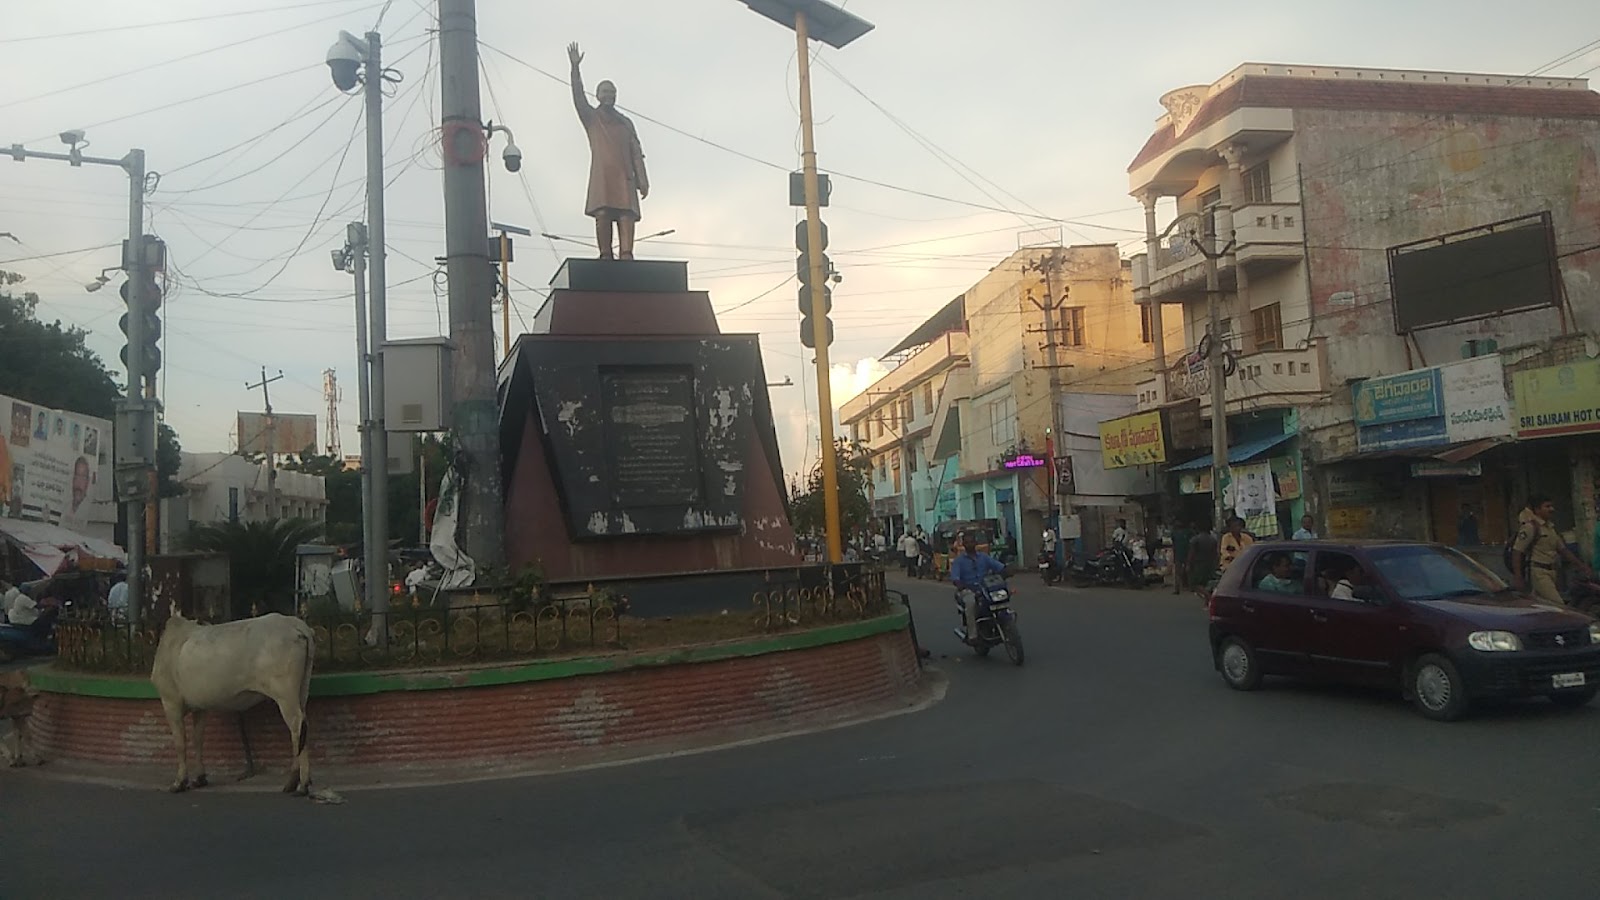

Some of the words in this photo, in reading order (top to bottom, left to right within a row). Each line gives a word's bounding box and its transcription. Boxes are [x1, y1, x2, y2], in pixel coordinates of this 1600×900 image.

[1520, 416, 1535, 428] SRI
[1537, 412, 1572, 427] SAIRAM
[1573, 408, 1592, 422] HOT
